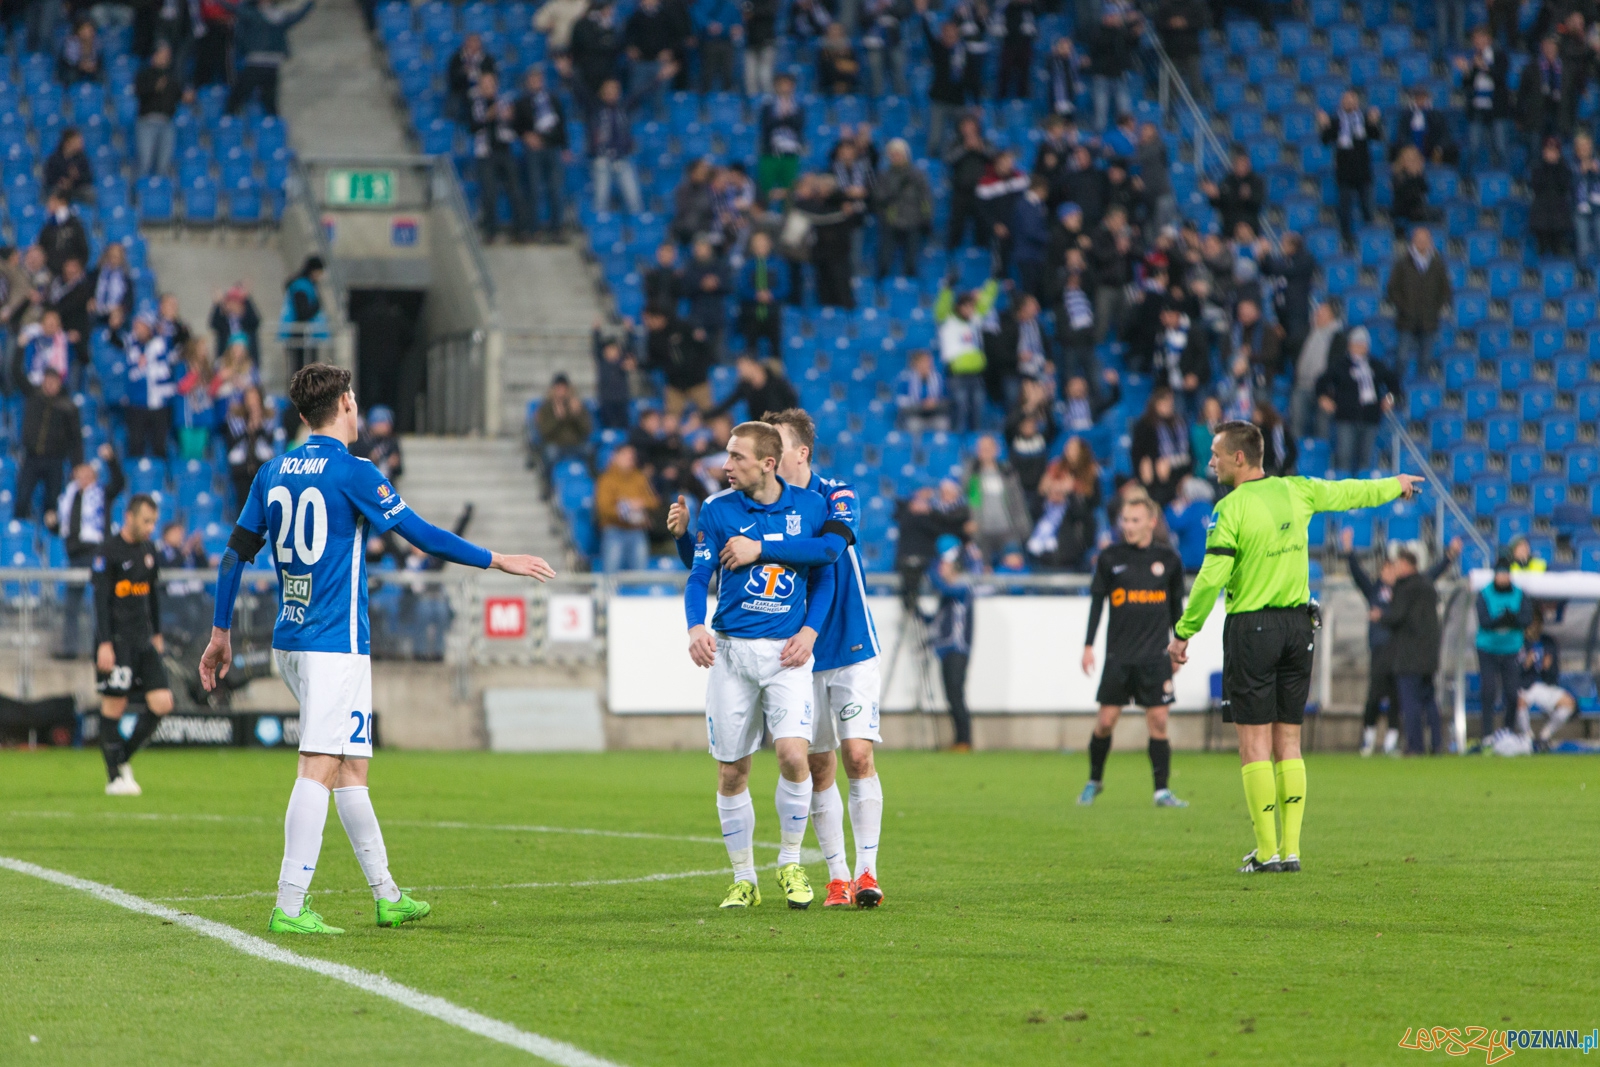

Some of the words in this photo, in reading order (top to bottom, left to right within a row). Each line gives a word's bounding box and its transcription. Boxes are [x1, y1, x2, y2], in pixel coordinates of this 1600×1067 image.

[279, 457, 329, 475] HOLMAN
[267, 486, 328, 566] 20
[285, 579, 309, 597] LECH
[744, 564, 797, 600] STS
[280, 604, 305, 625] PILS
[489, 602, 521, 633] M
[563, 604, 581, 631] 3
